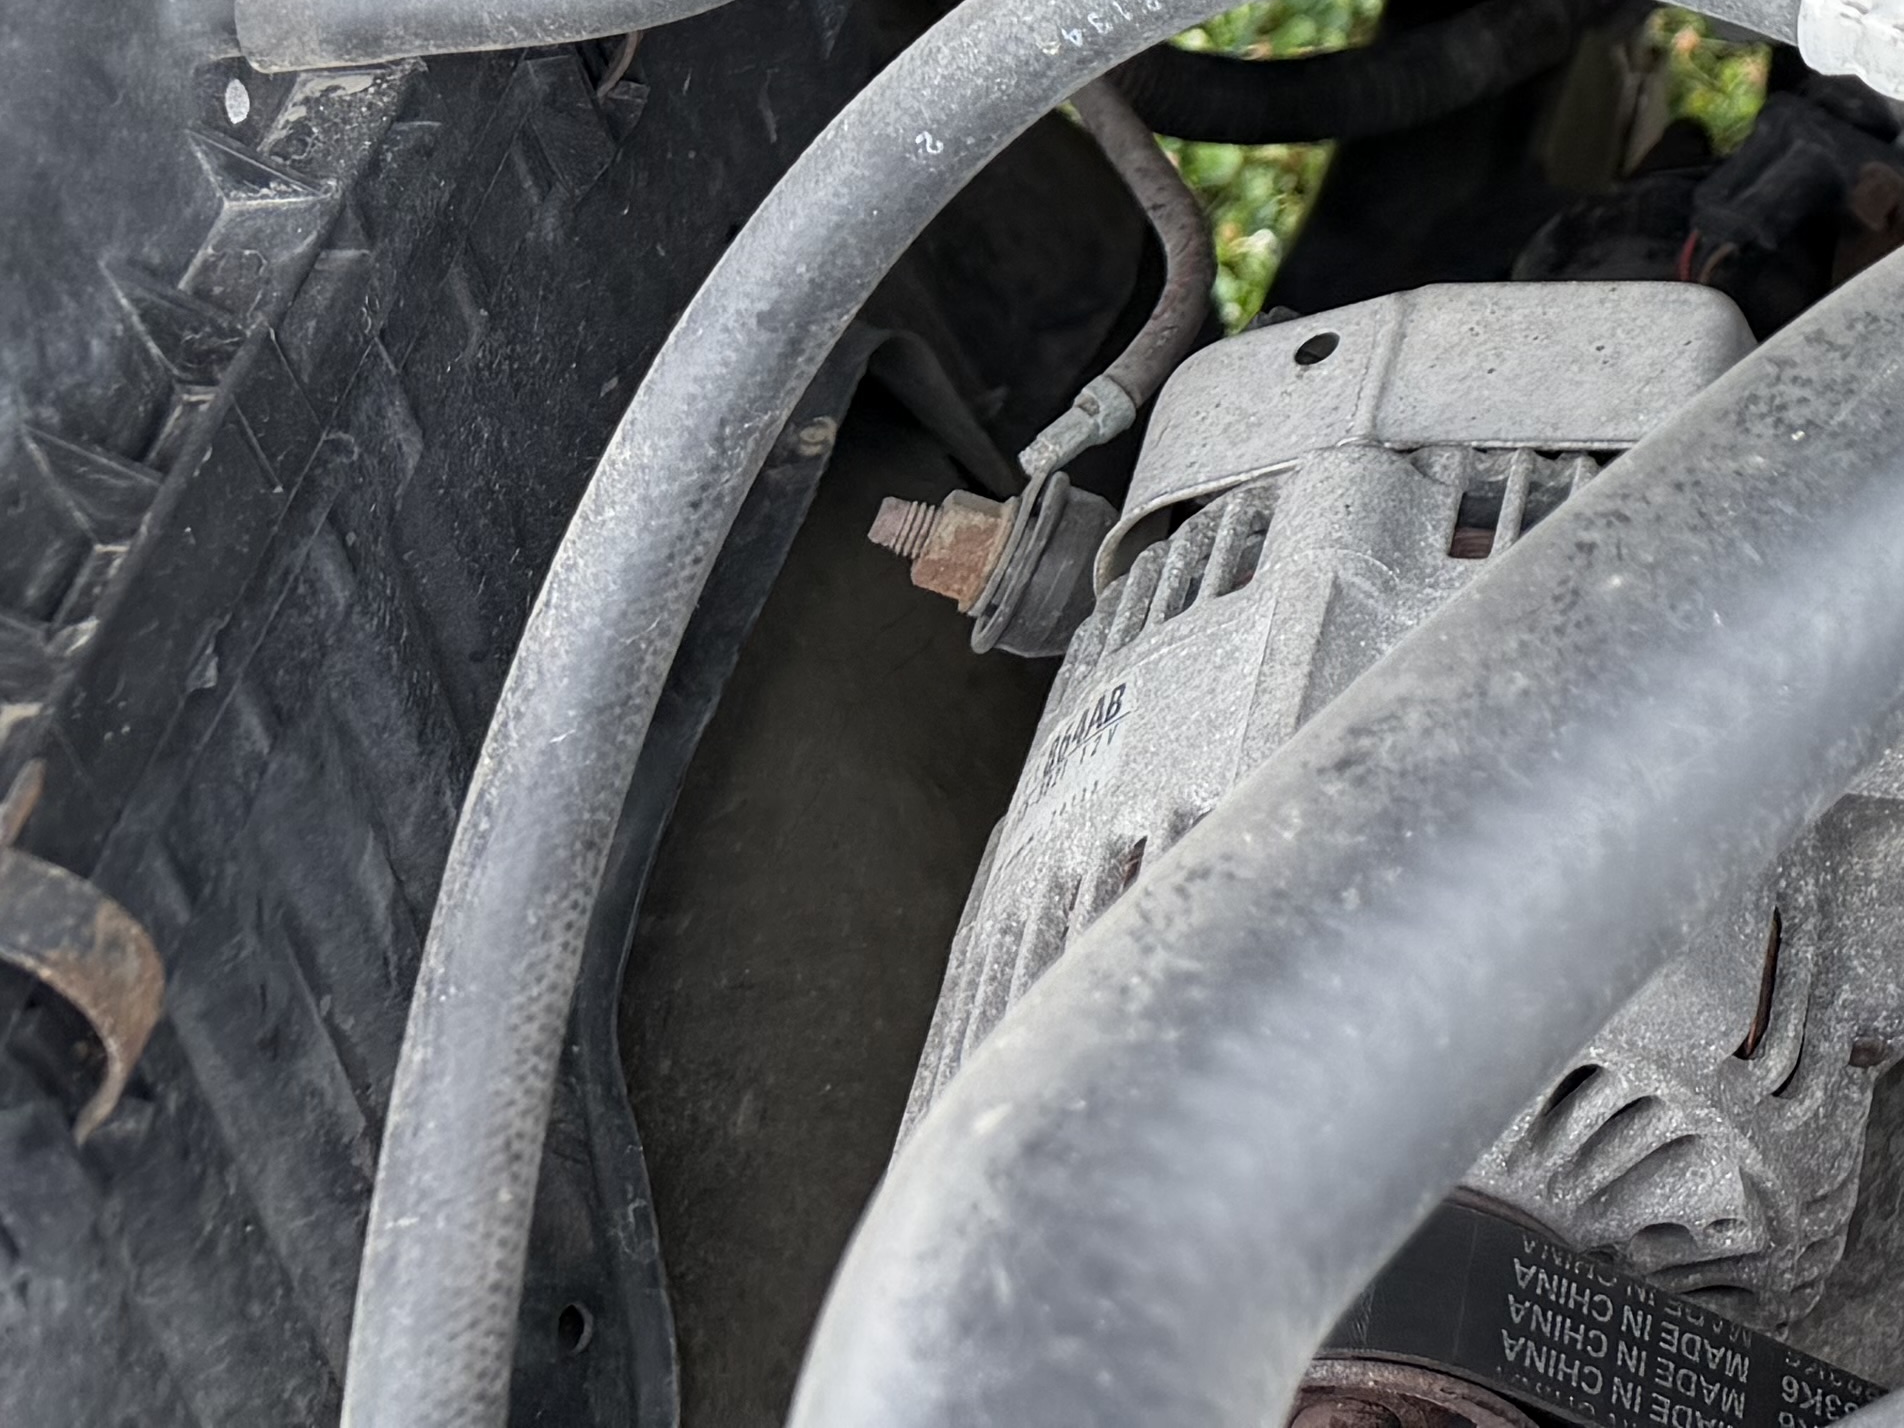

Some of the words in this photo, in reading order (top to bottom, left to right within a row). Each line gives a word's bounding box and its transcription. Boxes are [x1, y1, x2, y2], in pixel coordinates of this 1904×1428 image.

[1513, 1256, 1614, 1323] CHINA
[1507, 1293, 1609, 1359] CHINA
[1620, 1304, 1653, 1342] IN
[1659, 1320, 1750, 1384] MADE
[1501, 1328, 1603, 1396] CHINA
[1616, 1340, 1647, 1378] IN
[1654, 1356, 1746, 1420] MADE
[1611, 1375, 1643, 1414] IN
[1649, 1392, 1734, 1428] ADE
